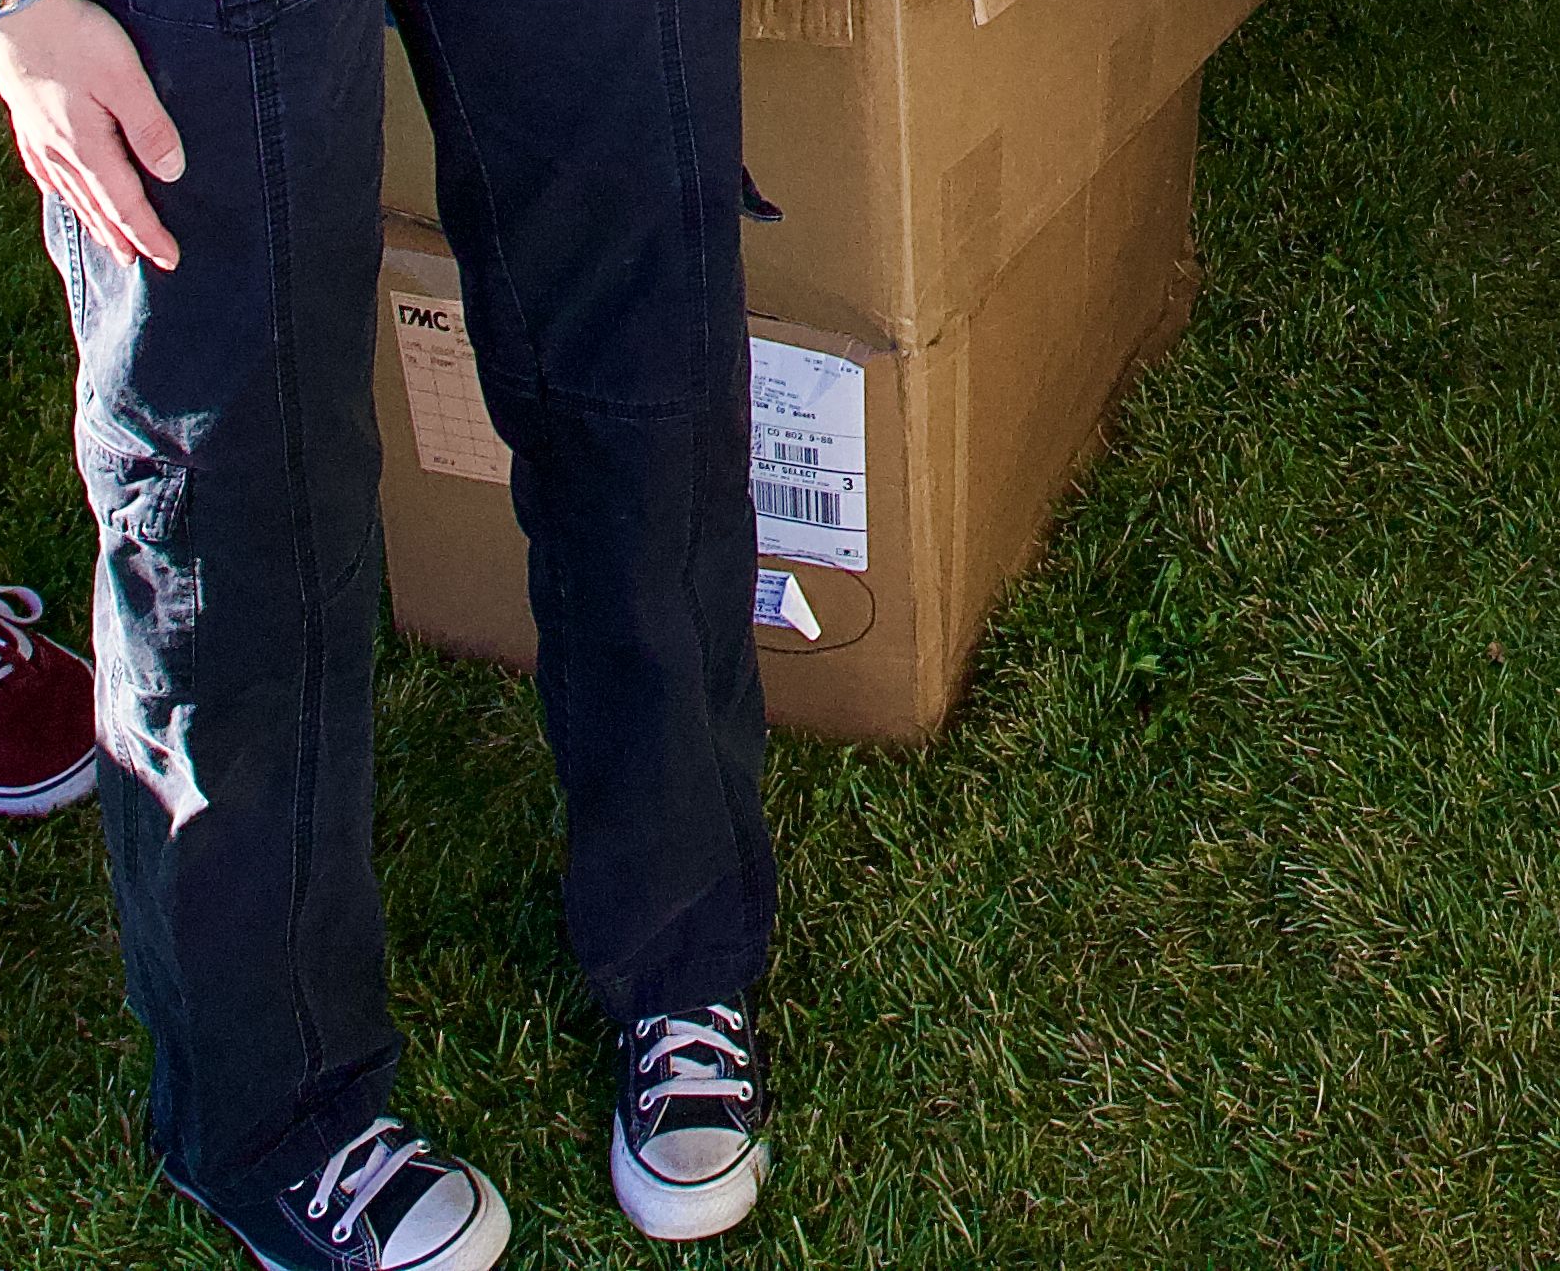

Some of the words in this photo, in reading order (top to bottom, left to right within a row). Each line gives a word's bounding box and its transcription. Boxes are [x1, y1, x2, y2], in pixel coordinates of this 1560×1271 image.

[767, 428, 780, 437] CO
[785, 431, 803, 441] 802
[782, 465, 818, 479] SELECT
[842, 476, 854, 491] 3
